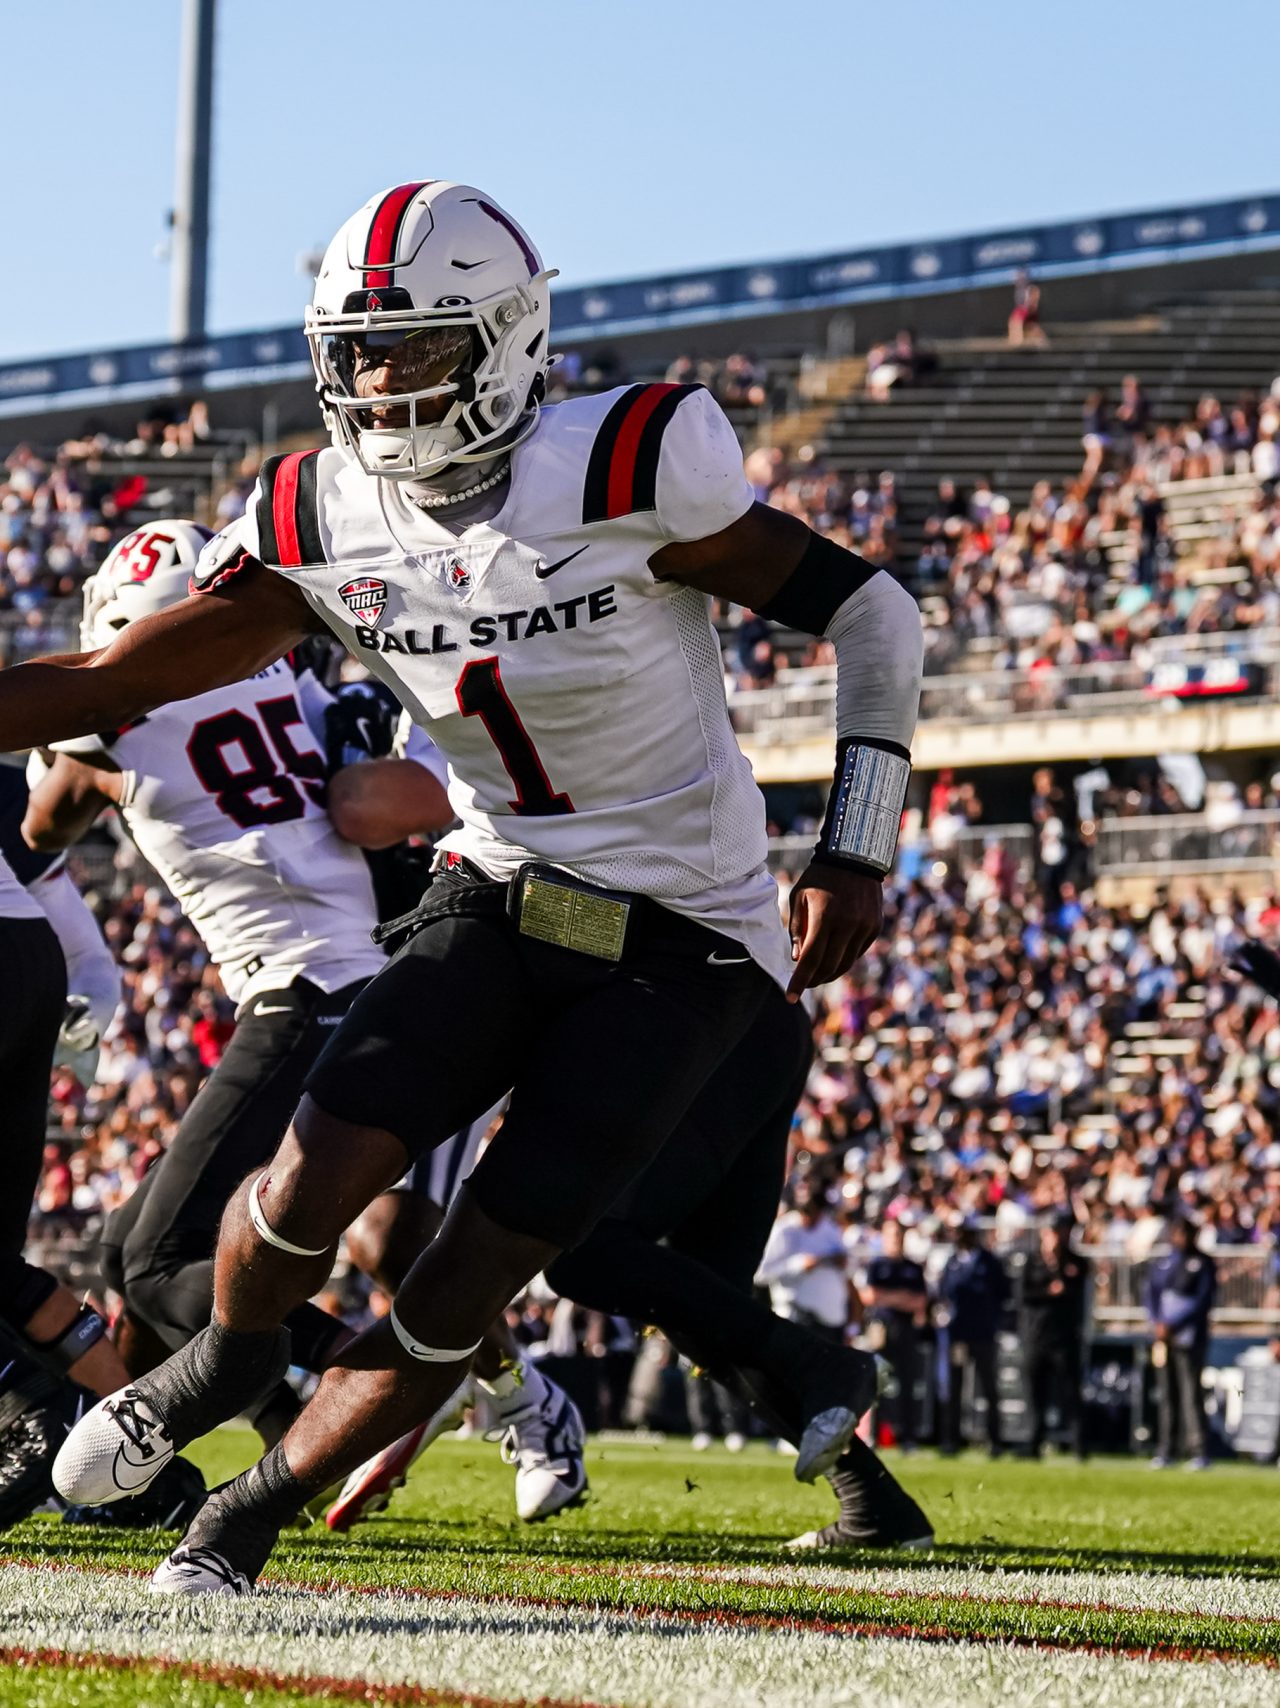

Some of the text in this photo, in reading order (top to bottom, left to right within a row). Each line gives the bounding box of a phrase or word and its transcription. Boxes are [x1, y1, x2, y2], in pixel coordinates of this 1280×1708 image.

[345, 589, 387, 609] MAC
[354, 583, 618, 655] BALL STATE
[185, 693, 328, 829] 85
[454, 655, 578, 817] 1
